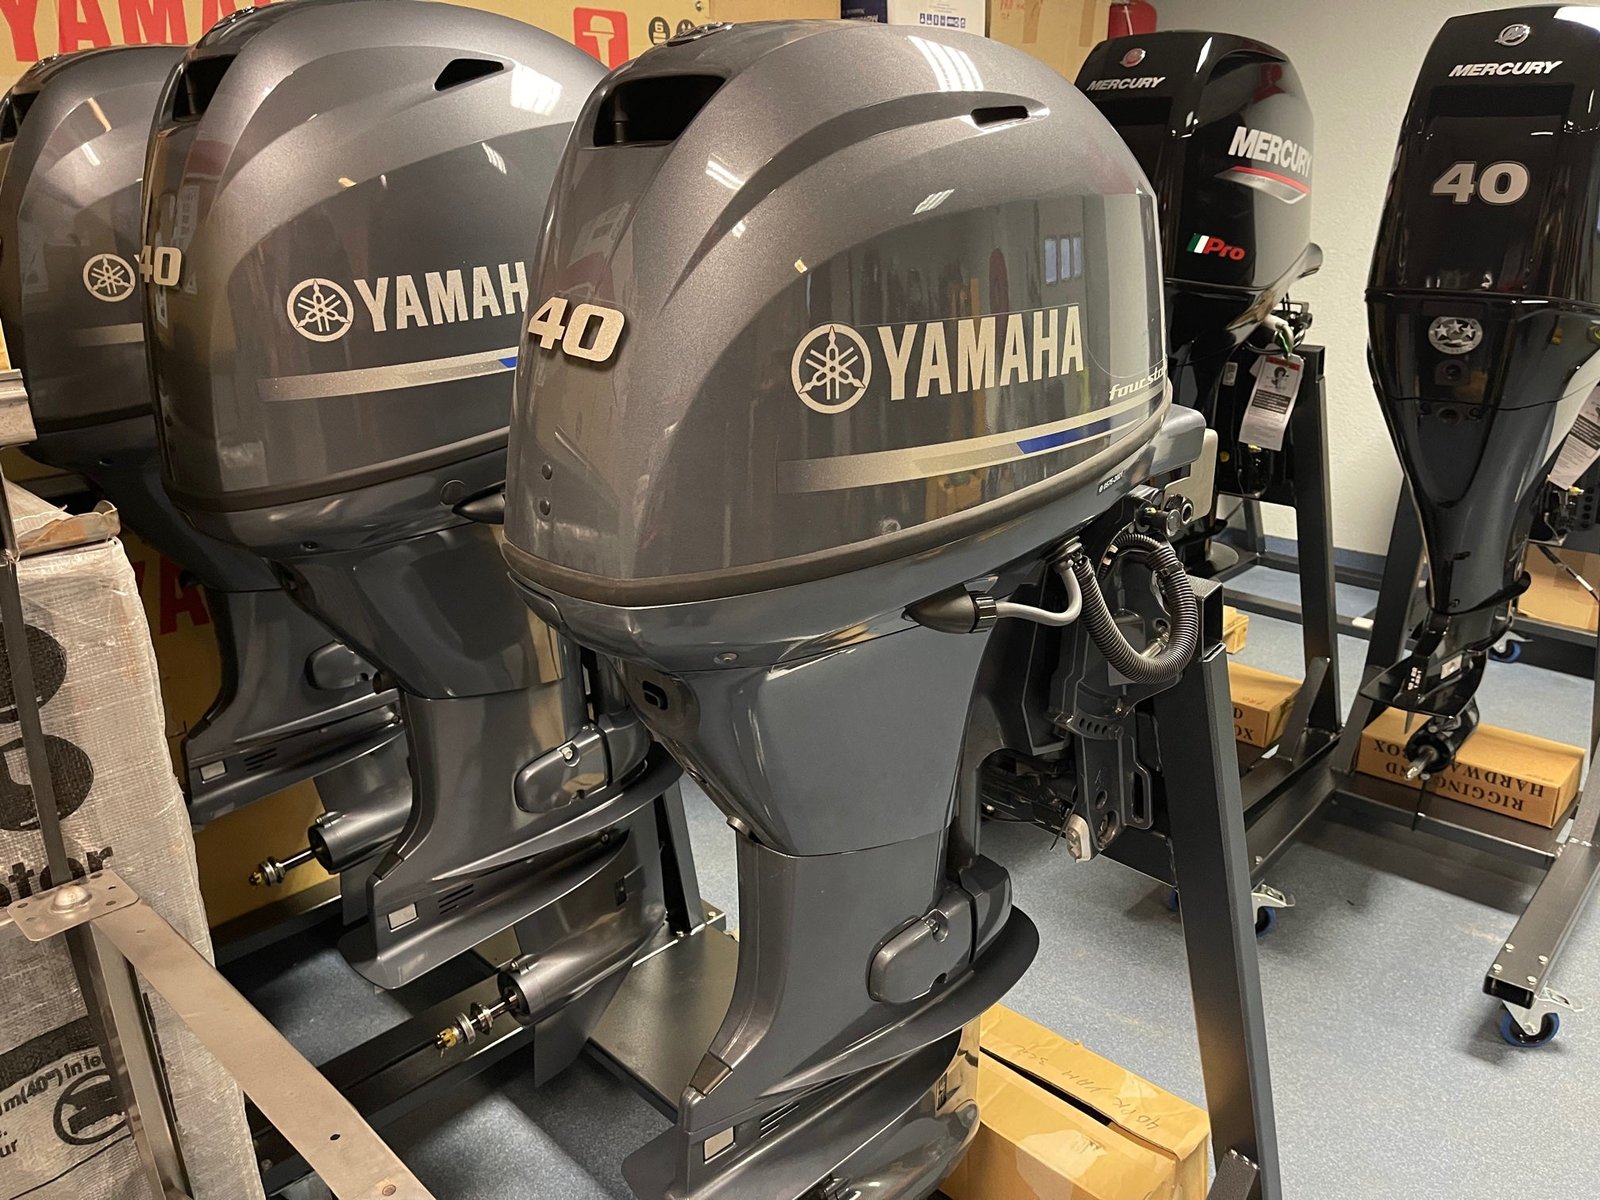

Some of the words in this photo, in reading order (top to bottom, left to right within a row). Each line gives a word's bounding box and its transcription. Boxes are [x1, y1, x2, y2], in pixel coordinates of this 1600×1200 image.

[1086, 76, 1166, 92] MERCURY
[1449, 60, 1563, 77] MERCURY
[1228, 126, 1312, 178] MERCURY
[1431, 161, 1530, 205] 40
[139, 245, 182, 286] 40
[1203, 237, 1246, 260] Pro
[353, 261, 529, 332] YAMAH
[527, 296, 625, 362] 40
[877, 305, 1084, 400] YAMAHA
[1374, 739, 1405, 757] OX
[1450, 763, 1544, 798] HARDWA
